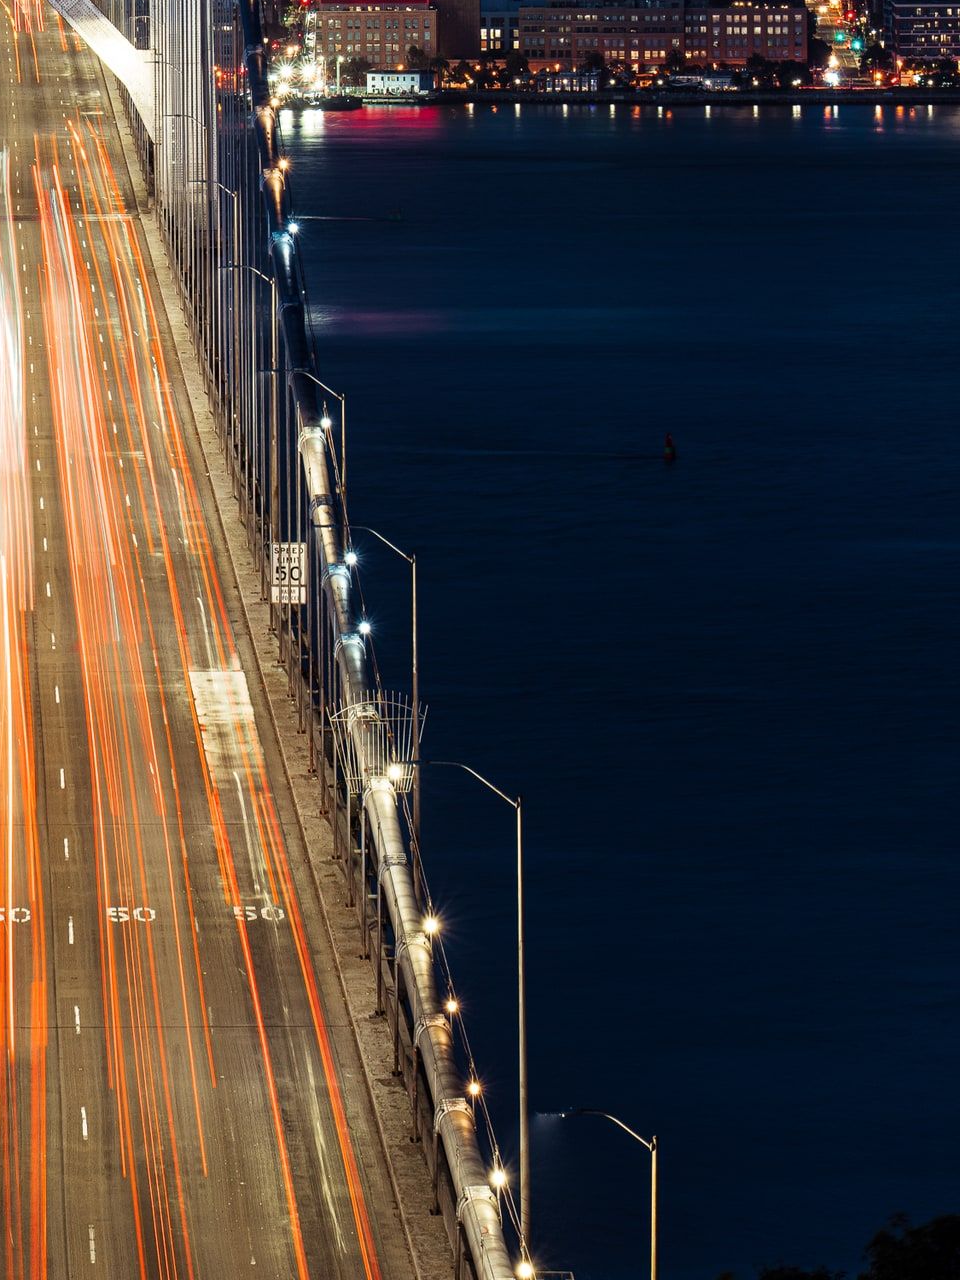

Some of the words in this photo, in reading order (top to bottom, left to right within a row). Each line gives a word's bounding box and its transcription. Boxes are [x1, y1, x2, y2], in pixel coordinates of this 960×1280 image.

[276, 566, 302, 581] 50
[107, 907, 156, 922] 50
[233, 906, 285, 921] 50
